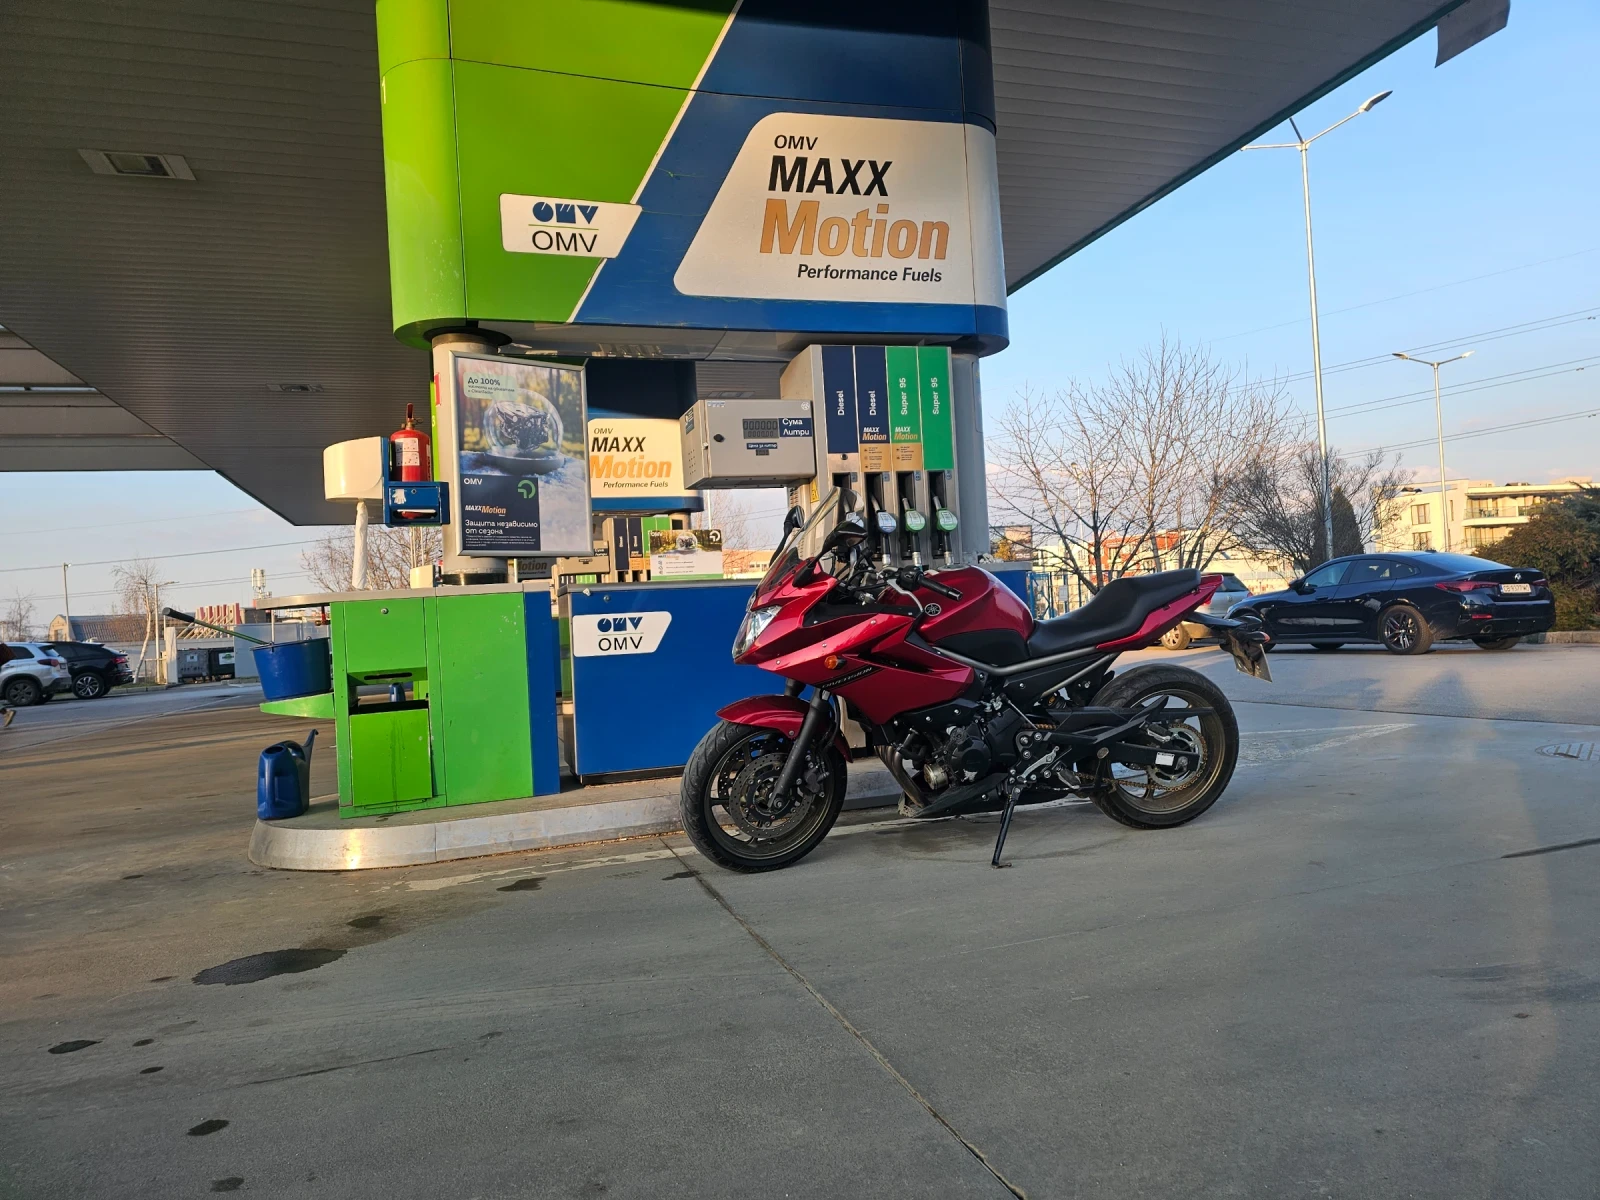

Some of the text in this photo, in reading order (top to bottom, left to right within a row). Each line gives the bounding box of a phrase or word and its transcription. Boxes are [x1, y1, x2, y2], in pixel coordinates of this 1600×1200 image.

[774, 134, 818, 150] OMV
[768, 155, 893, 196] MAXX
[760, 198, 950, 260] Motion
[532, 230, 598, 252] OMV
[797, 264, 942, 282] Performance Fuels
[467, 376, 501, 386] До 100%
[836, 390, 845, 416] Diesel
[868, 390, 877, 416] Diesel
[899, 377, 909, 415] Super 95
[931, 377, 940, 415] Super 95
[782, 418, 803, 426] Сума
[591, 437, 646, 452] MAXX
[590, 455, 672, 479] Motion
[463, 477, 483, 485] OMV
[465, 519, 538, 528] Защита независимо
[478, 528, 503, 536] сезона
[598, 636, 643, 652] OMV
